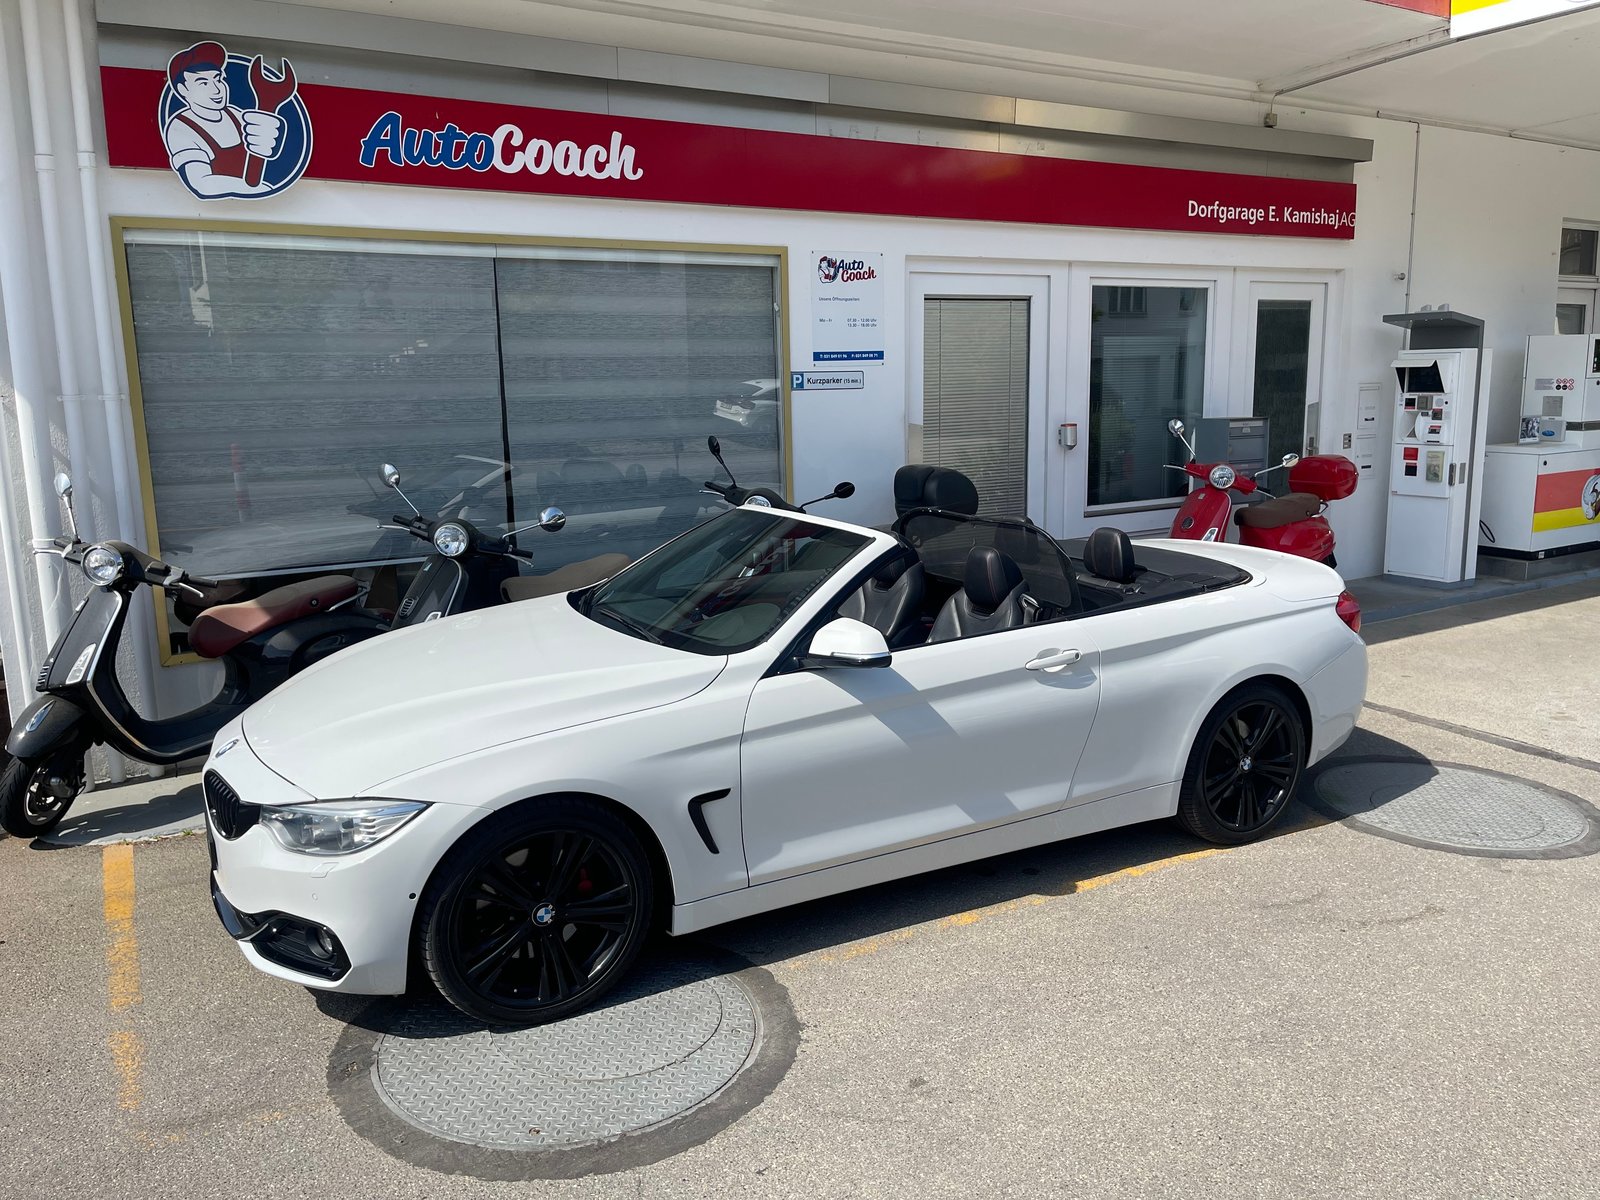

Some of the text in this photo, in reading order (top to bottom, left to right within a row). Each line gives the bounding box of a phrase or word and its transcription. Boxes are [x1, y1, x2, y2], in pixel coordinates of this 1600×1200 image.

[1187, 200, 1265, 225] Dorfgarage
[1268, 206, 1280, 222] E.
[837, 258, 864, 274] Auto
[841, 266, 877, 282] Coach
[793, 374, 802, 388] P
[807, 377, 843, 386] Kurzparker
